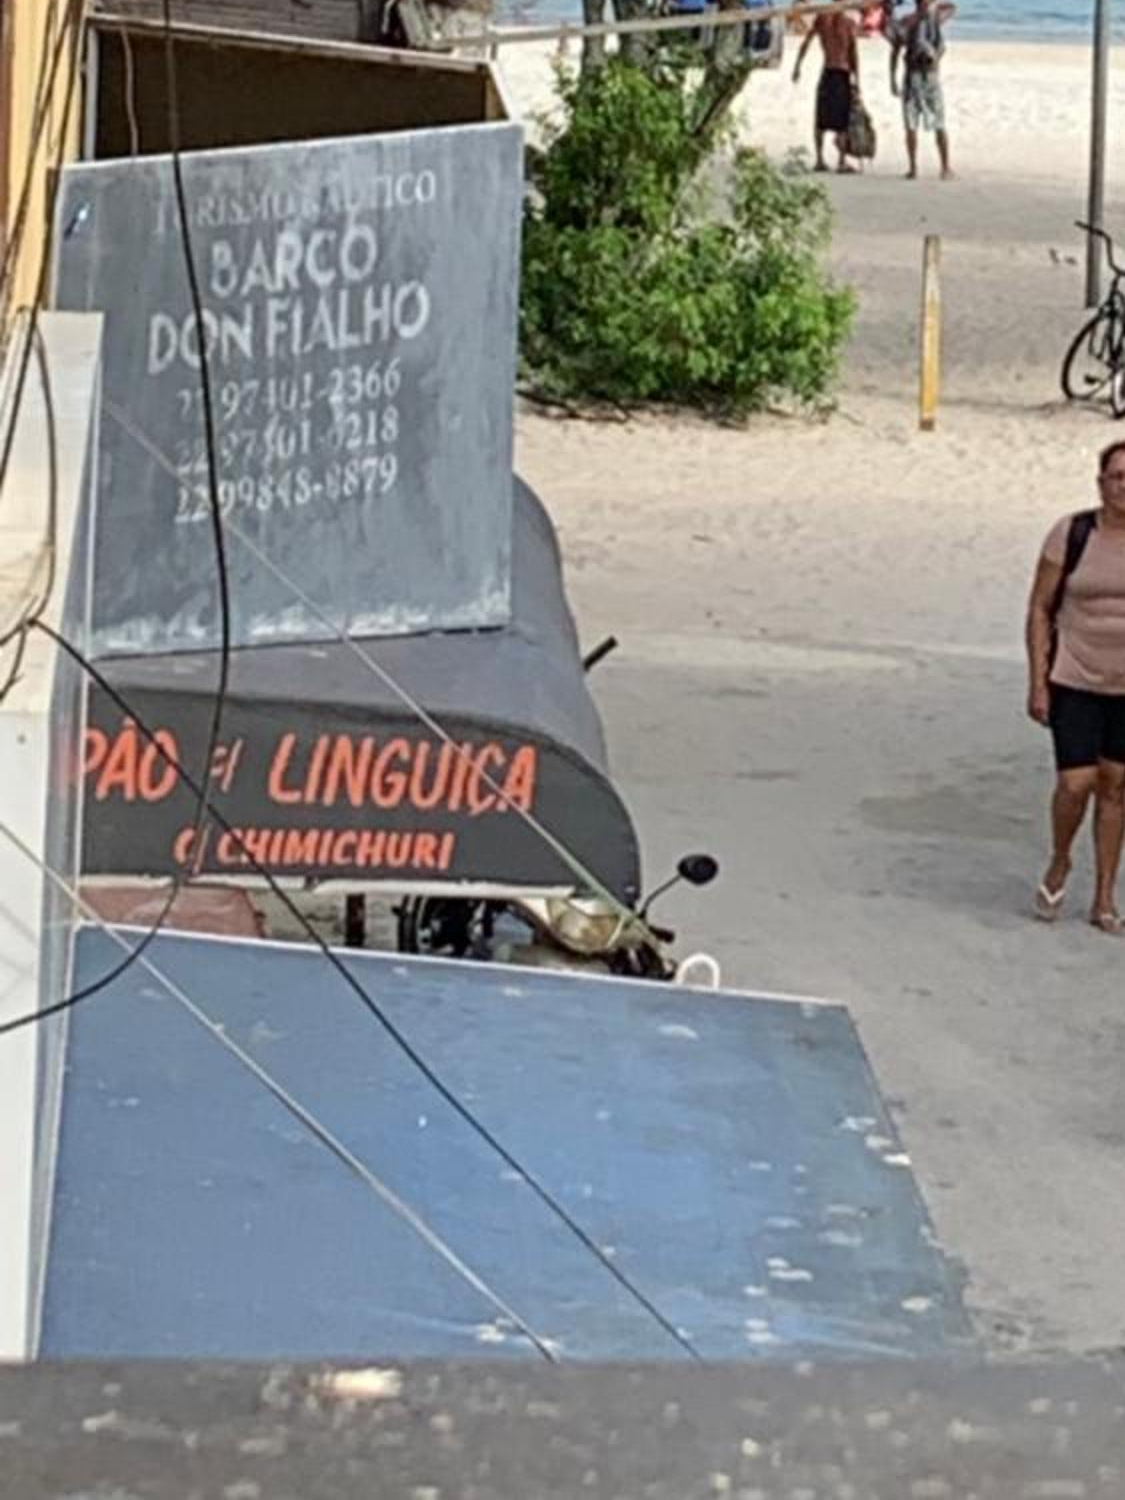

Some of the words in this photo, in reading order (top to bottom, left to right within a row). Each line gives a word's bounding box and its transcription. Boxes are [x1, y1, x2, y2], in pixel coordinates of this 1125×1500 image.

[210, 222, 378, 297] BARCO
[147, 311, 254, 376] DON
[264, 282, 430, 359] FIALHO
[83, 717, 178, 802] PÃO
[268, 731, 537, 816] LINGUIÇA
[216, 827, 456, 871] CHIMICHURI
